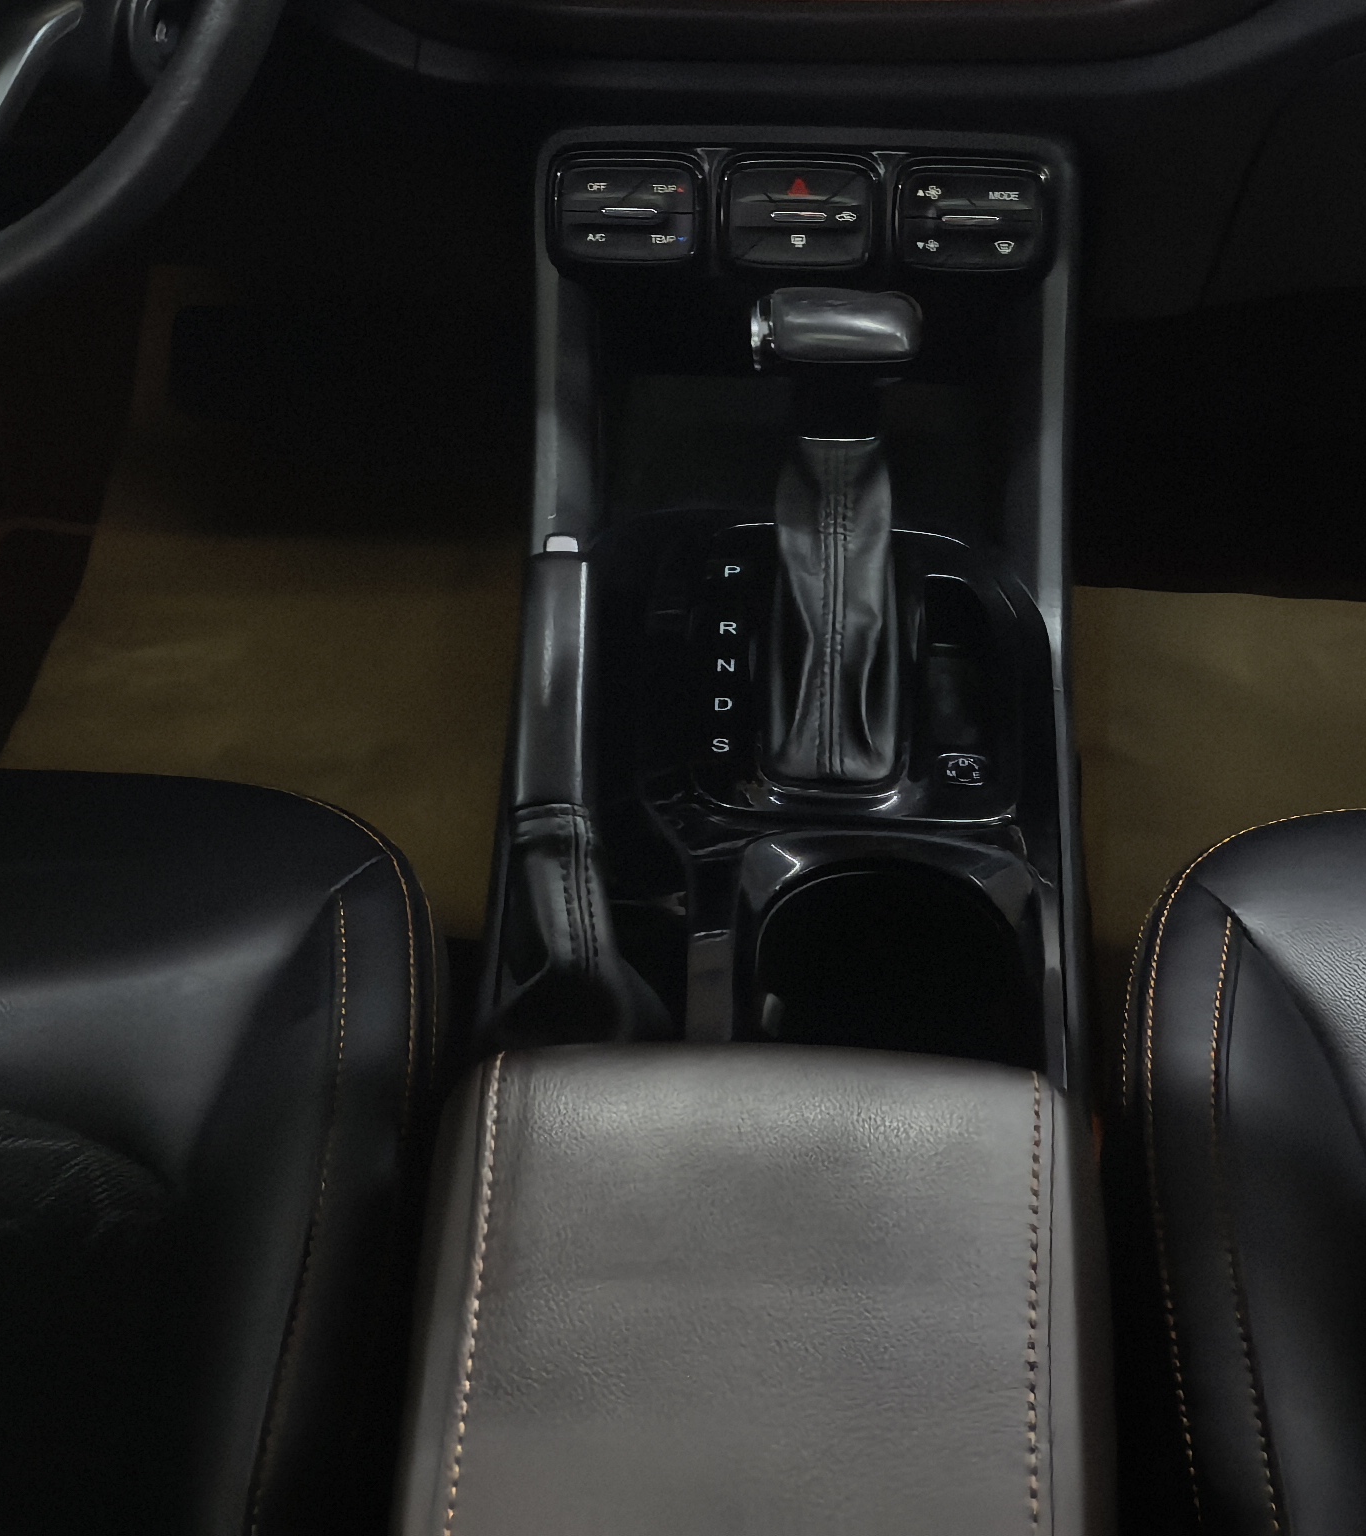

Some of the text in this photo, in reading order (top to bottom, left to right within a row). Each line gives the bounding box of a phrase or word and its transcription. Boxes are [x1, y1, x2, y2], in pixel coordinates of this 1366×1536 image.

[587, 182, 608, 192] OFF
[652, 184, 677, 194] TEMP
[988, 191, 1020, 201] MODE
[586, 233, 606, 242] A/C
[650, 234, 677, 244] TEMP
[724, 565, 741, 578] P
[719, 621, 737, 635] R
[716, 658, 736, 673] N
[714, 697, 733, 712] D
[711, 737, 730, 753] S
